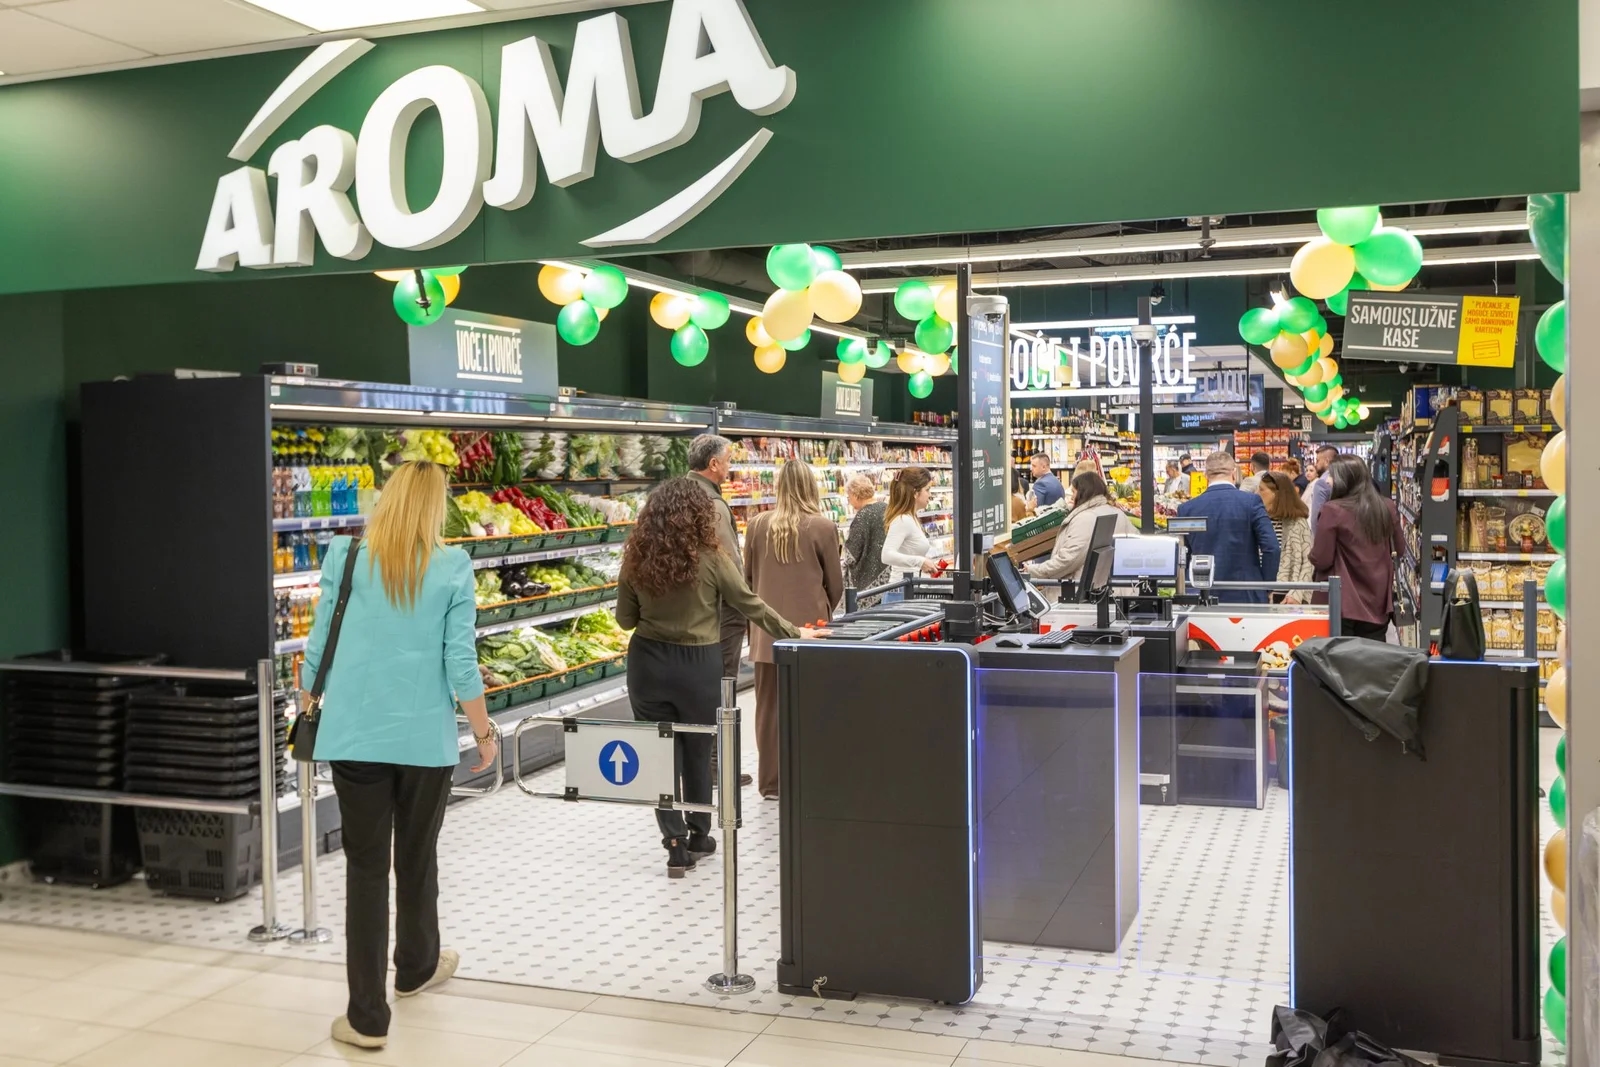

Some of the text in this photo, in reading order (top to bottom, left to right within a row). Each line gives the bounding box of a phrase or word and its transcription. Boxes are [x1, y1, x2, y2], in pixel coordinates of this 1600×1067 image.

[195, 0, 797, 271] AROMA
[1351, 305, 1457, 329] SAMOUSLUŽNE
[1464, 317, 1480, 325] SAMO
[1382, 327, 1420, 348] KASE
[1475, 326, 1502, 335] KARTICOM
[456, 325, 522, 375] VOĆE I POVRĆE
[1009, 330, 1062, 390] OĆE
[1070, 336, 1081, 388] I
